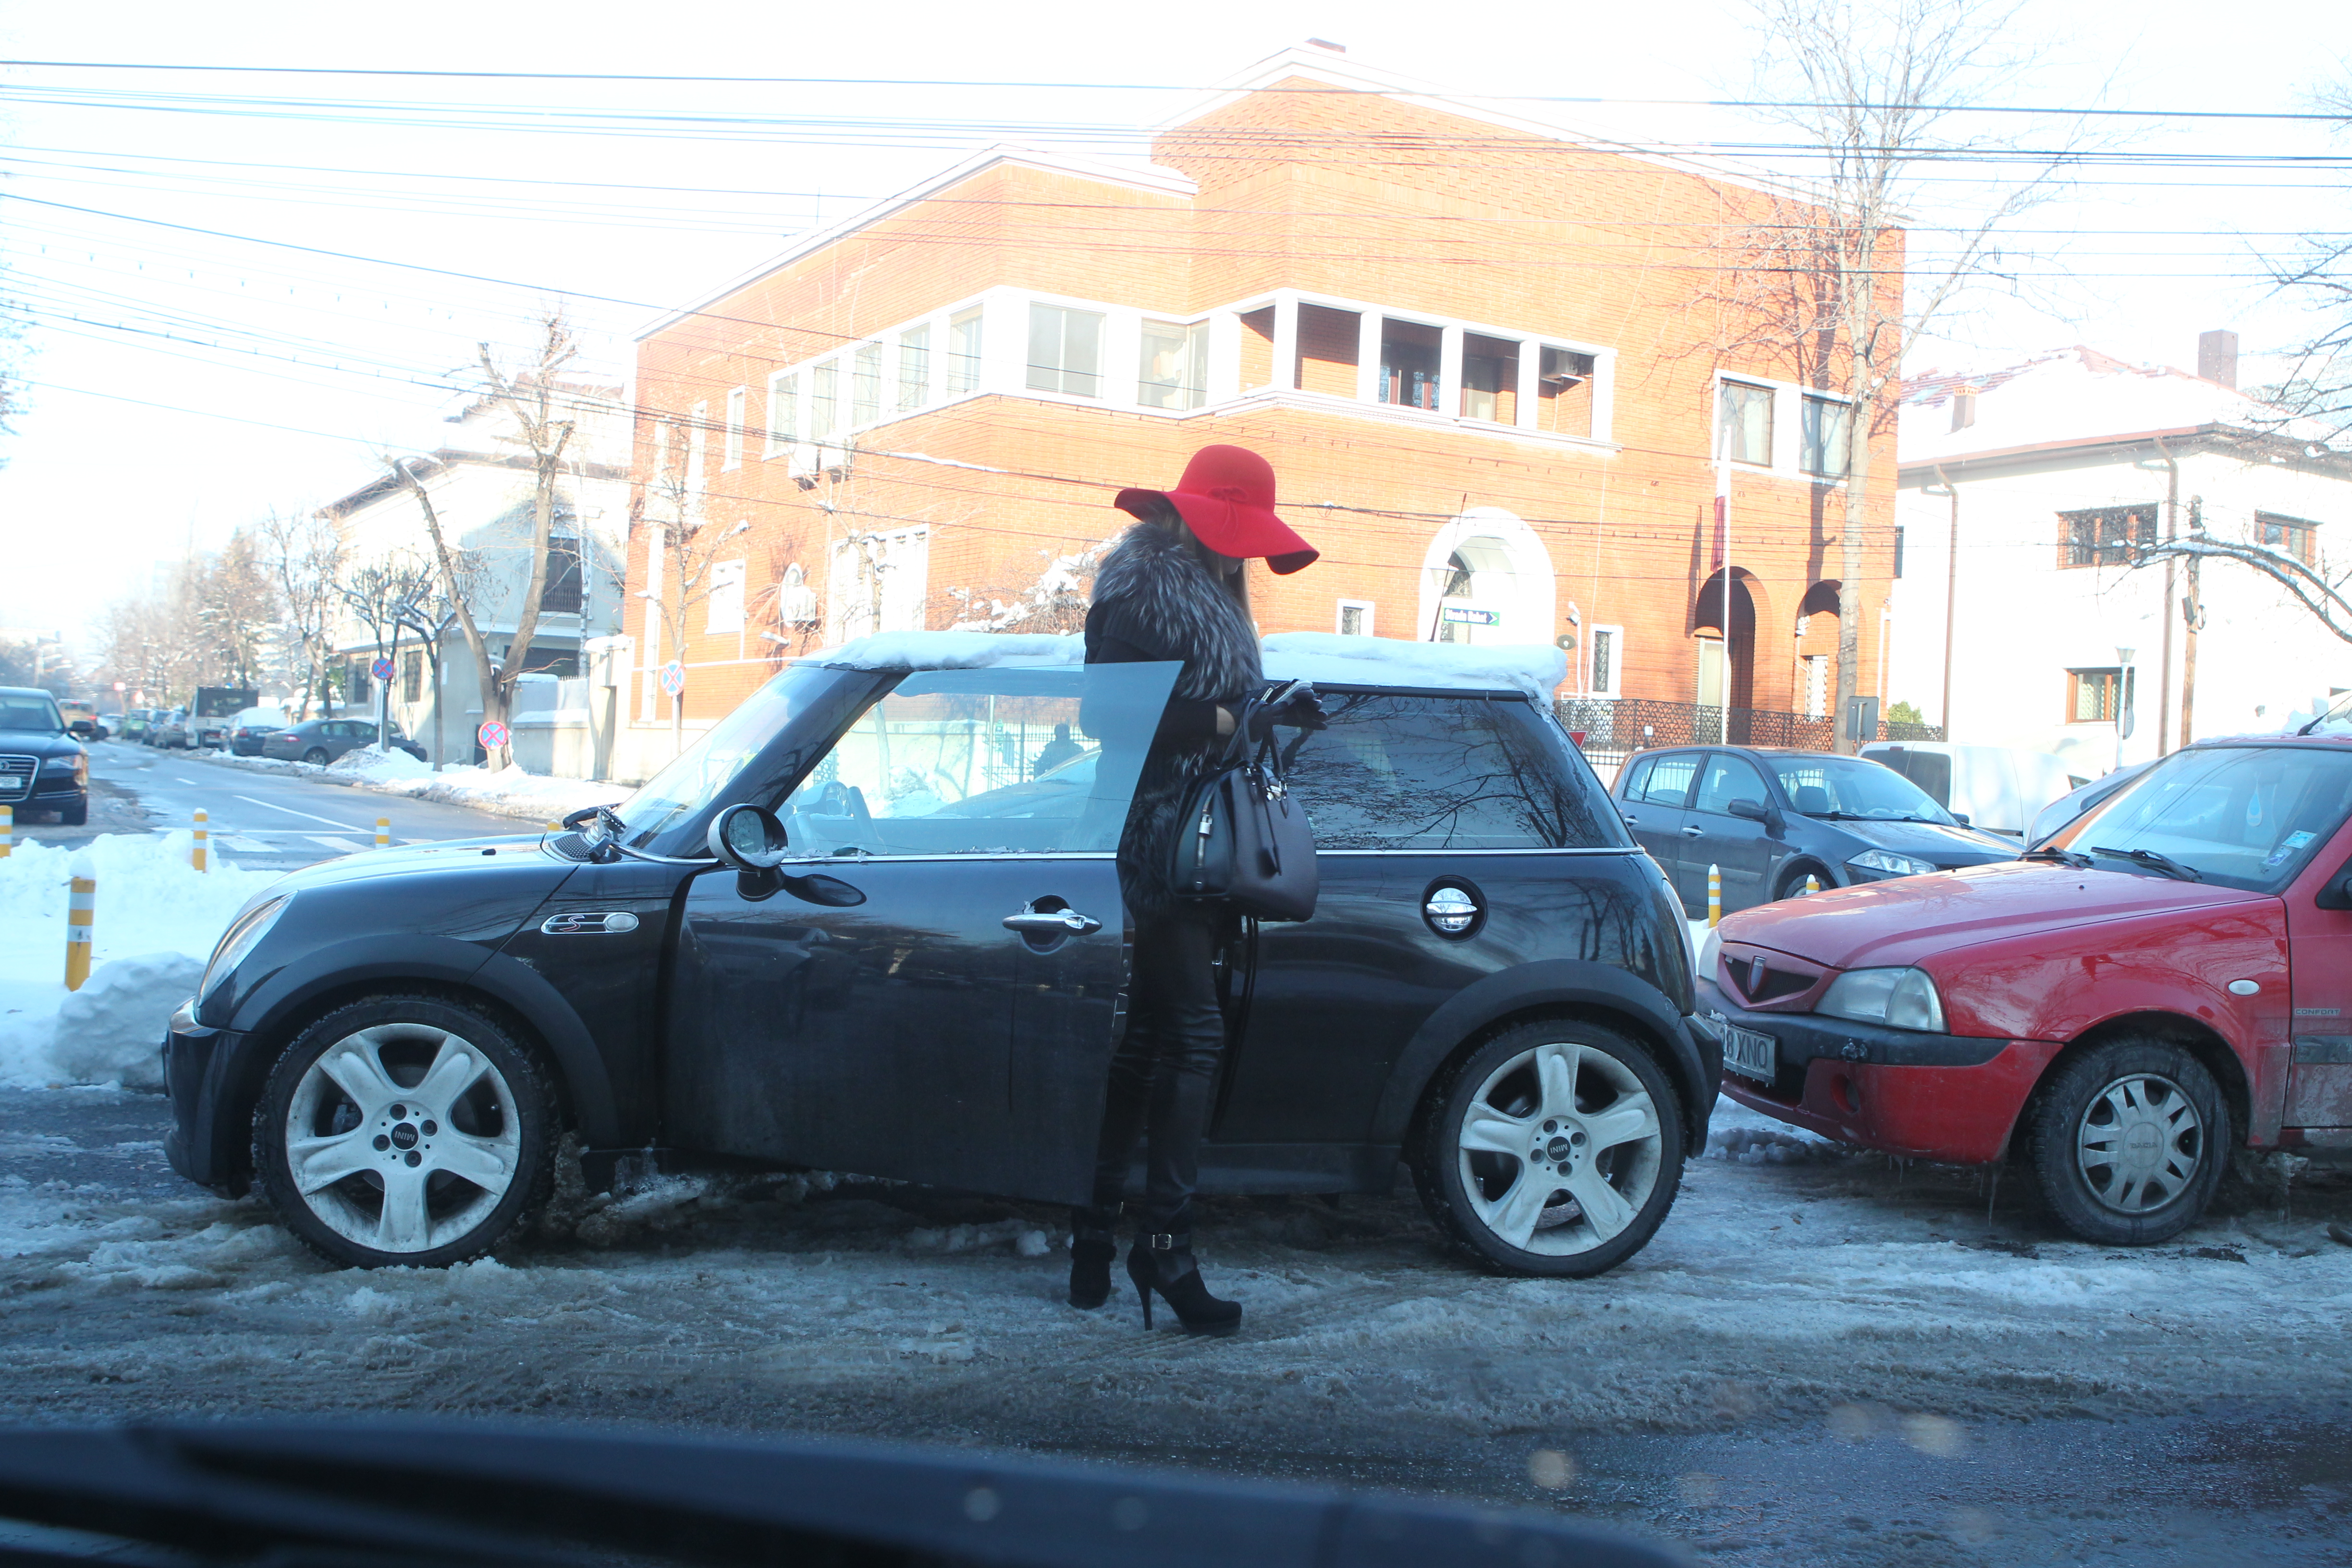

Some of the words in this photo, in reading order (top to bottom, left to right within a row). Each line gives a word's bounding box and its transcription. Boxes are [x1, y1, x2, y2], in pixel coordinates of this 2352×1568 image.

[1445, 608, 1467, 622] Strada
[559, 915, 585, 932] S
[1737, 1032, 1767, 1069] XNO
[394, 1131, 415, 1141] MINI
[1550, 1144, 1568, 1154] MINI
